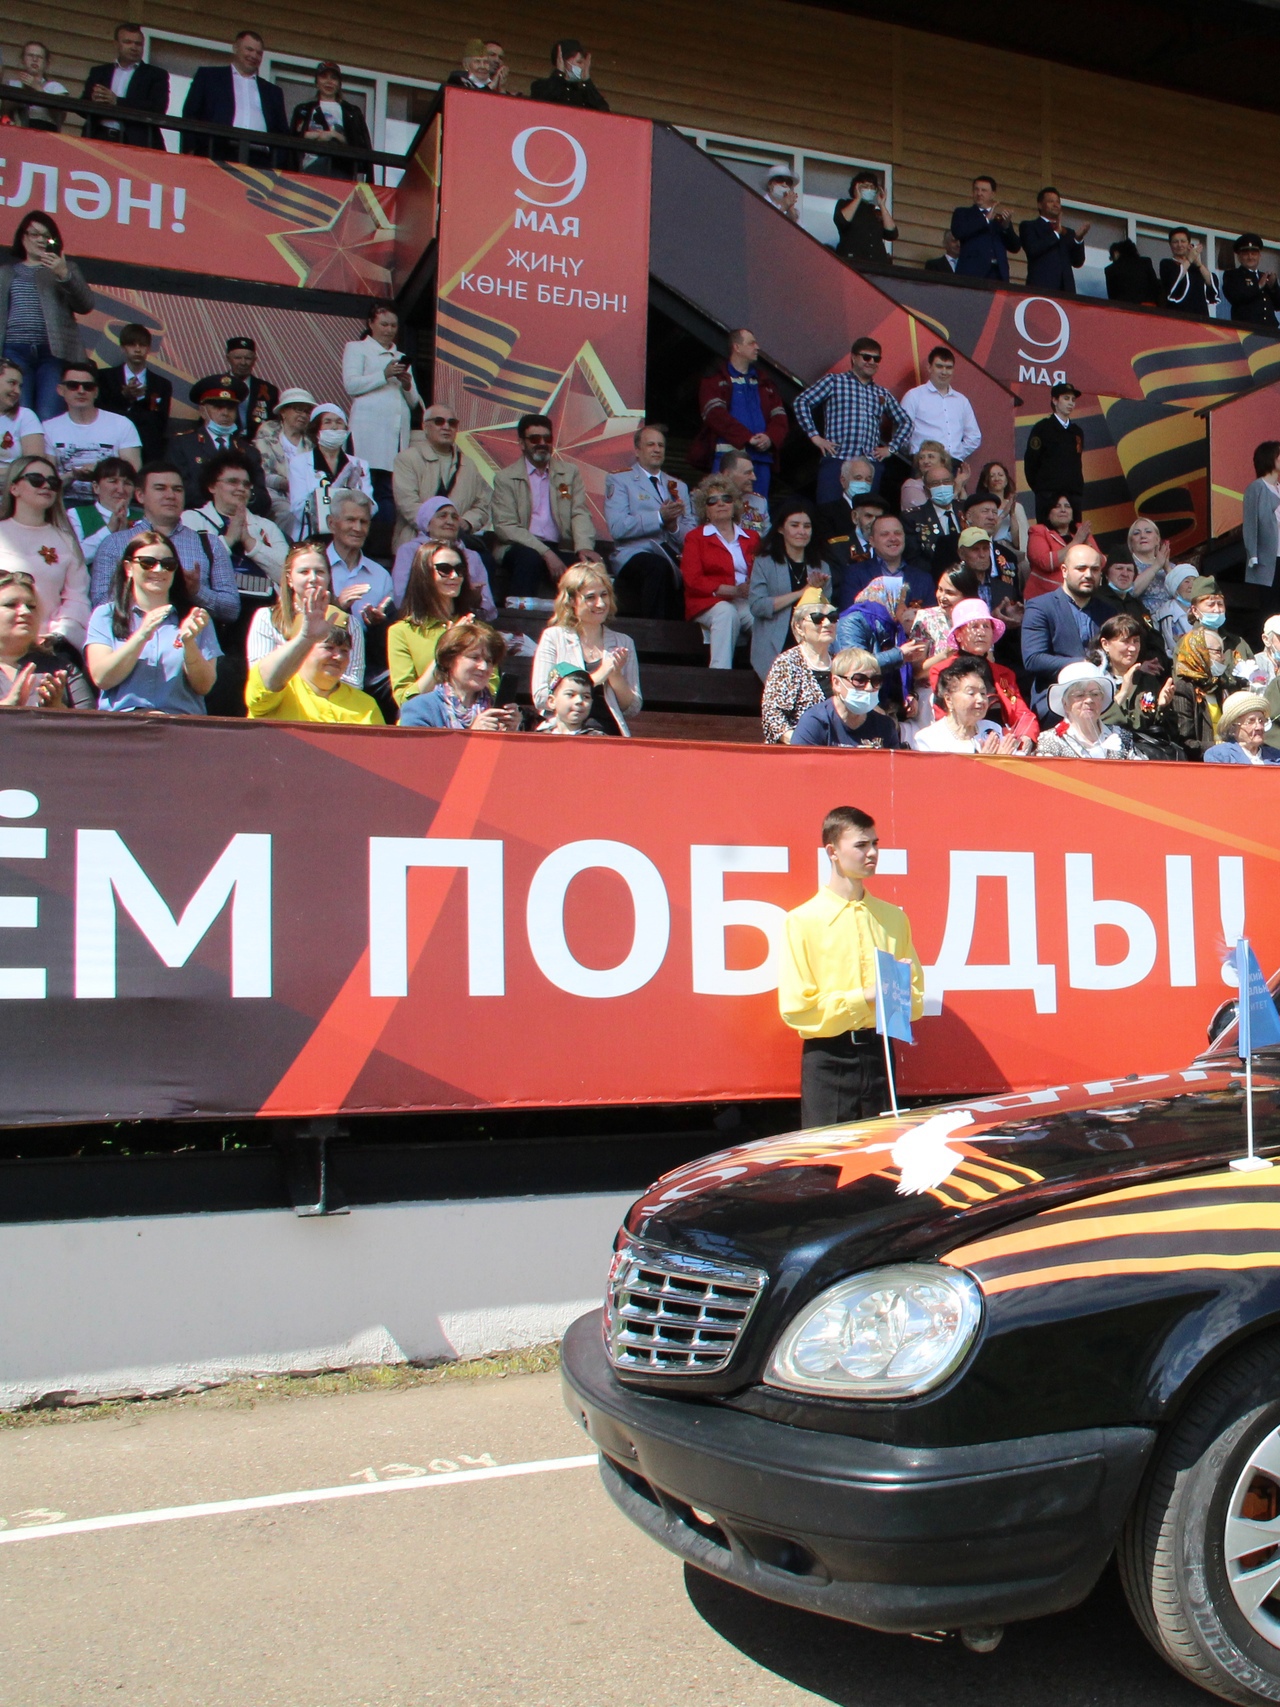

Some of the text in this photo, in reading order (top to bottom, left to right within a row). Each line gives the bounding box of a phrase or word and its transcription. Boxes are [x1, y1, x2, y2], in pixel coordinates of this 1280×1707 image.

[511, 126, 588, 207] 9
[0, 157, 187, 234] ЛӘН!
[514, 208, 580, 238] МАЯ
[460, 271, 628, 313] КӨНЕ БЕЛӘН!
[1014, 296, 1070, 363] 9
[1018, 365, 1066, 386] МАЯ
